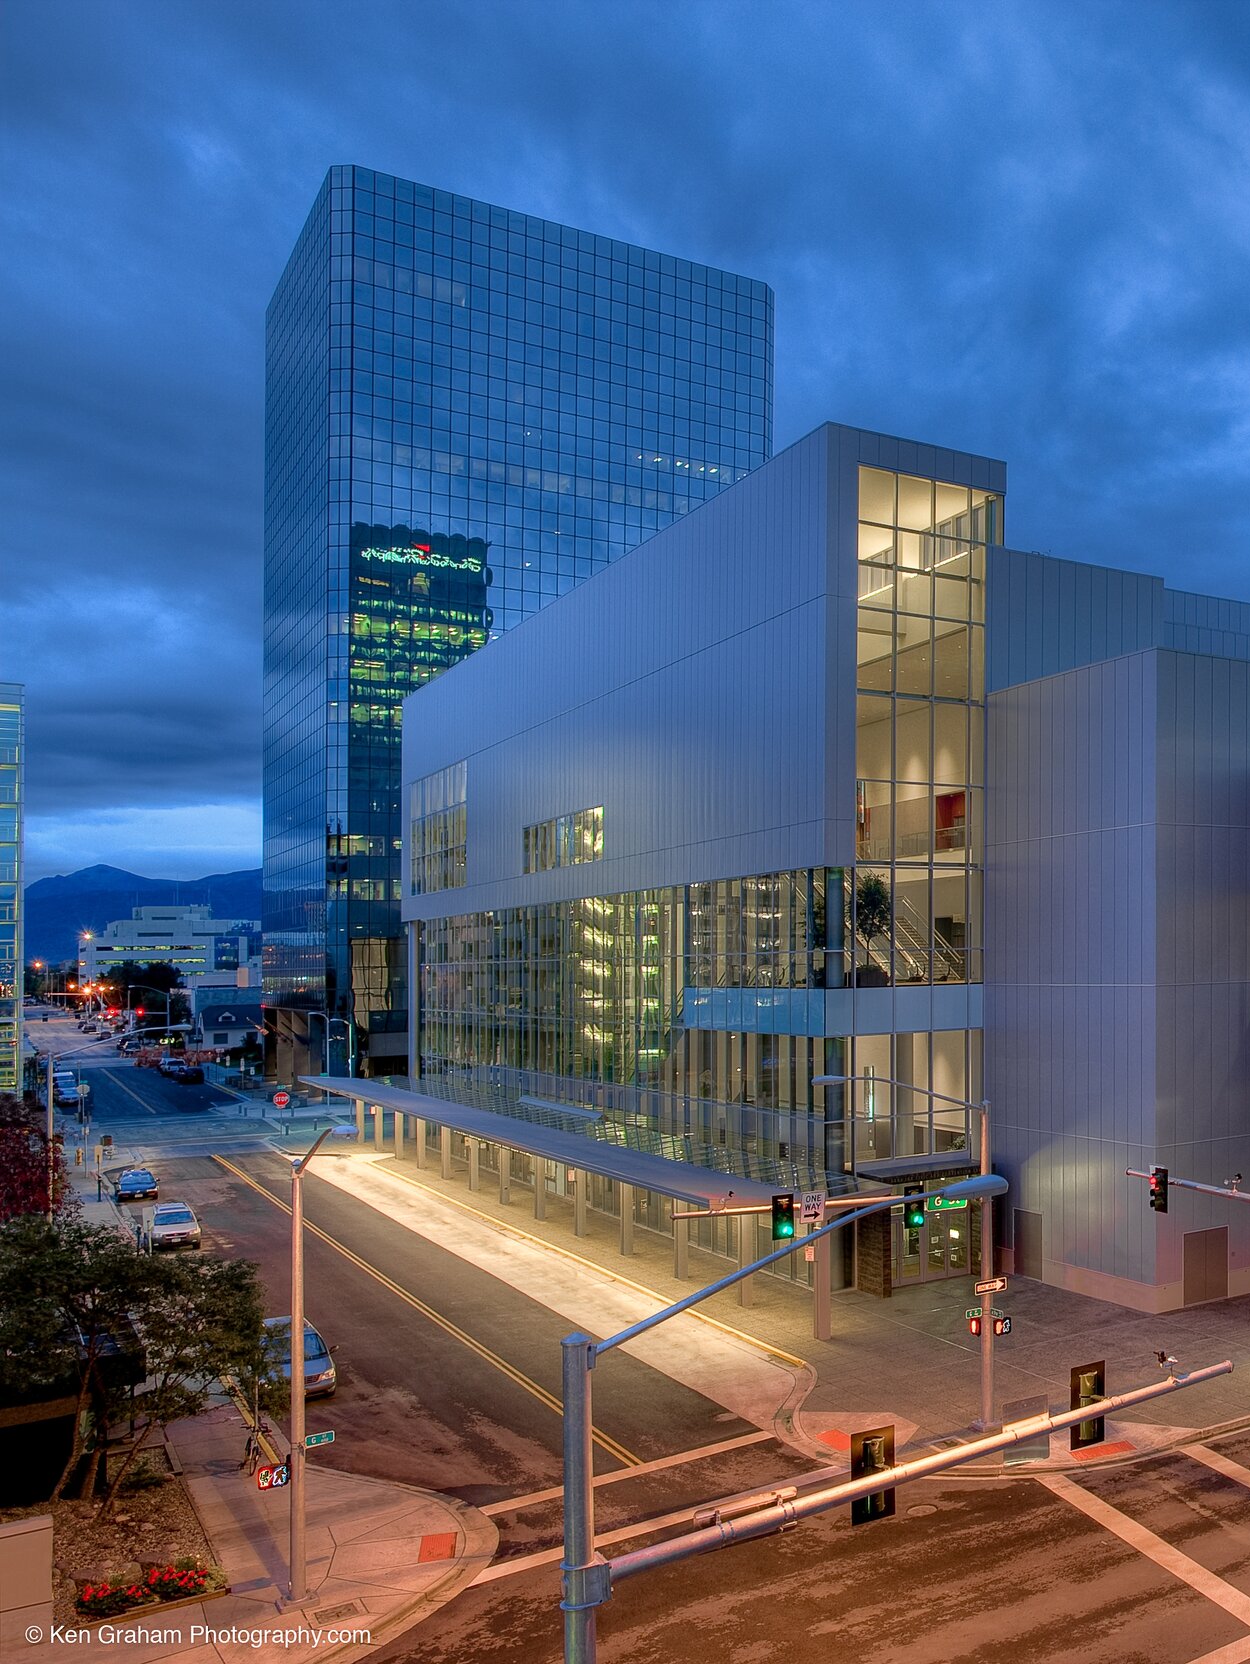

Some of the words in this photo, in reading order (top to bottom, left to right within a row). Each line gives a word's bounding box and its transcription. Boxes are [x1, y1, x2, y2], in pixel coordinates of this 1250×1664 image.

[805, 1194, 822, 1203] ONE
[934, 1196, 942, 1206] G
[805, 1202, 822, 1211] WAY
[311, 1436, 317, 1444] G
